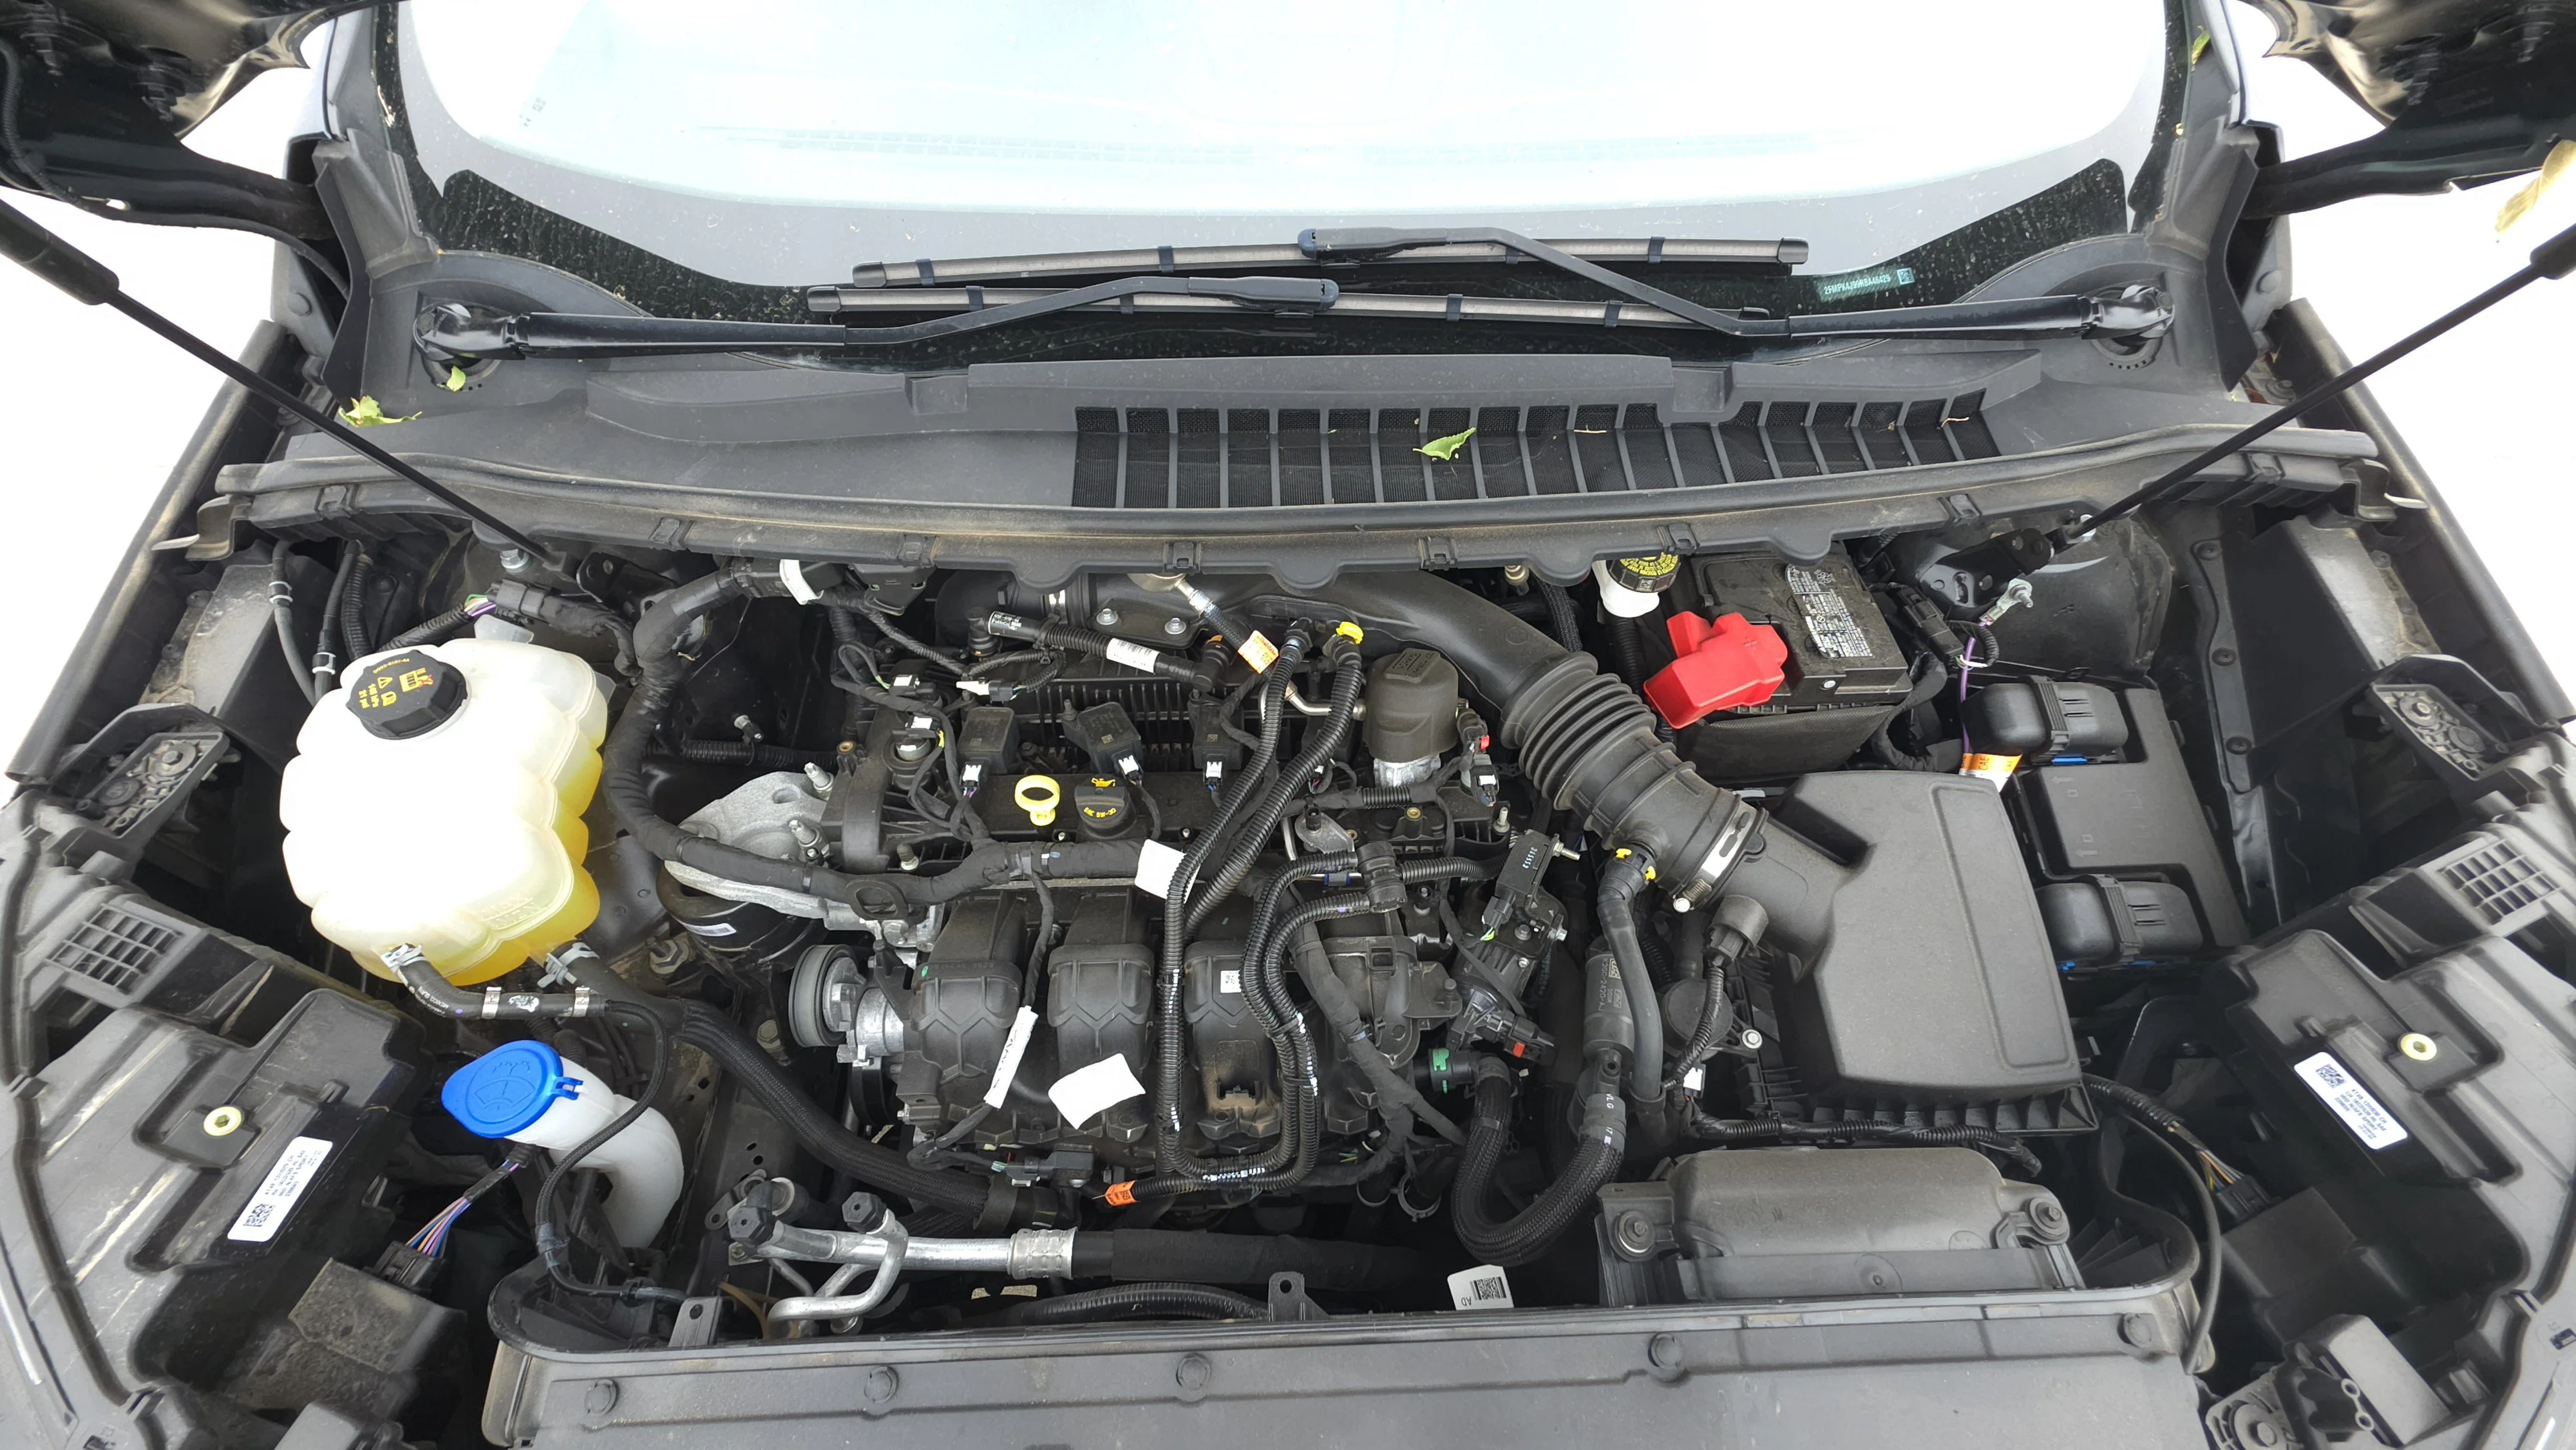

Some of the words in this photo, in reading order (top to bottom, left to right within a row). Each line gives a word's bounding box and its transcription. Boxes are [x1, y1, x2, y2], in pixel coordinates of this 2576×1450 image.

[1083, 807, 1094, 816] SAE
[1096, 807, 1116, 818] 5W-30
[1461, 1297, 1472, 1306] AD
